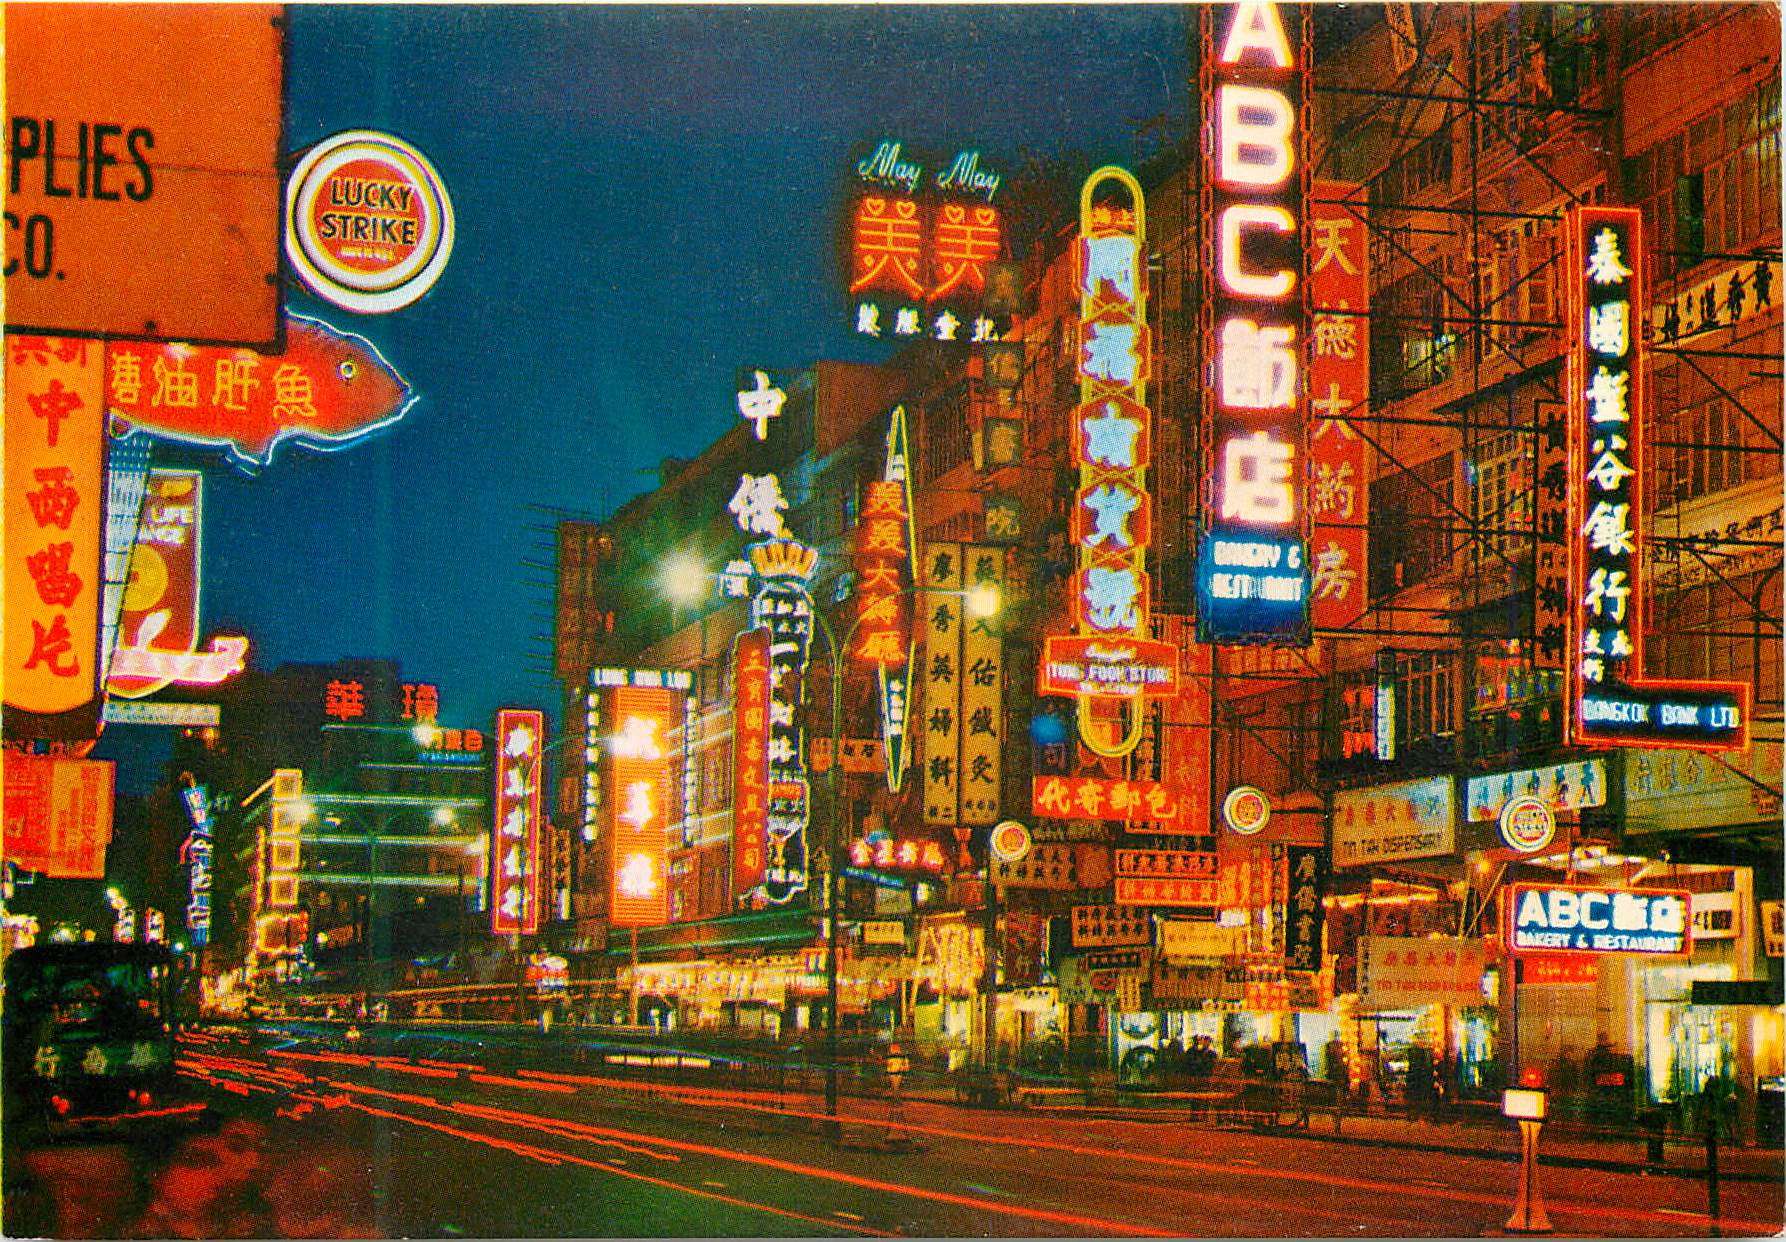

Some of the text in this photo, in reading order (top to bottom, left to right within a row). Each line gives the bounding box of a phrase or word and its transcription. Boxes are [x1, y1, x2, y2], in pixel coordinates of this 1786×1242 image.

[858, 142, 1002, 203] May May
[330, 176, 416, 213] LUCKY
[321, 212, 417, 247] STRIKE
[850, 199, 1001, 301] 美美
[1517, 929, 1685, 952] BAKERY & RESTAURANT
